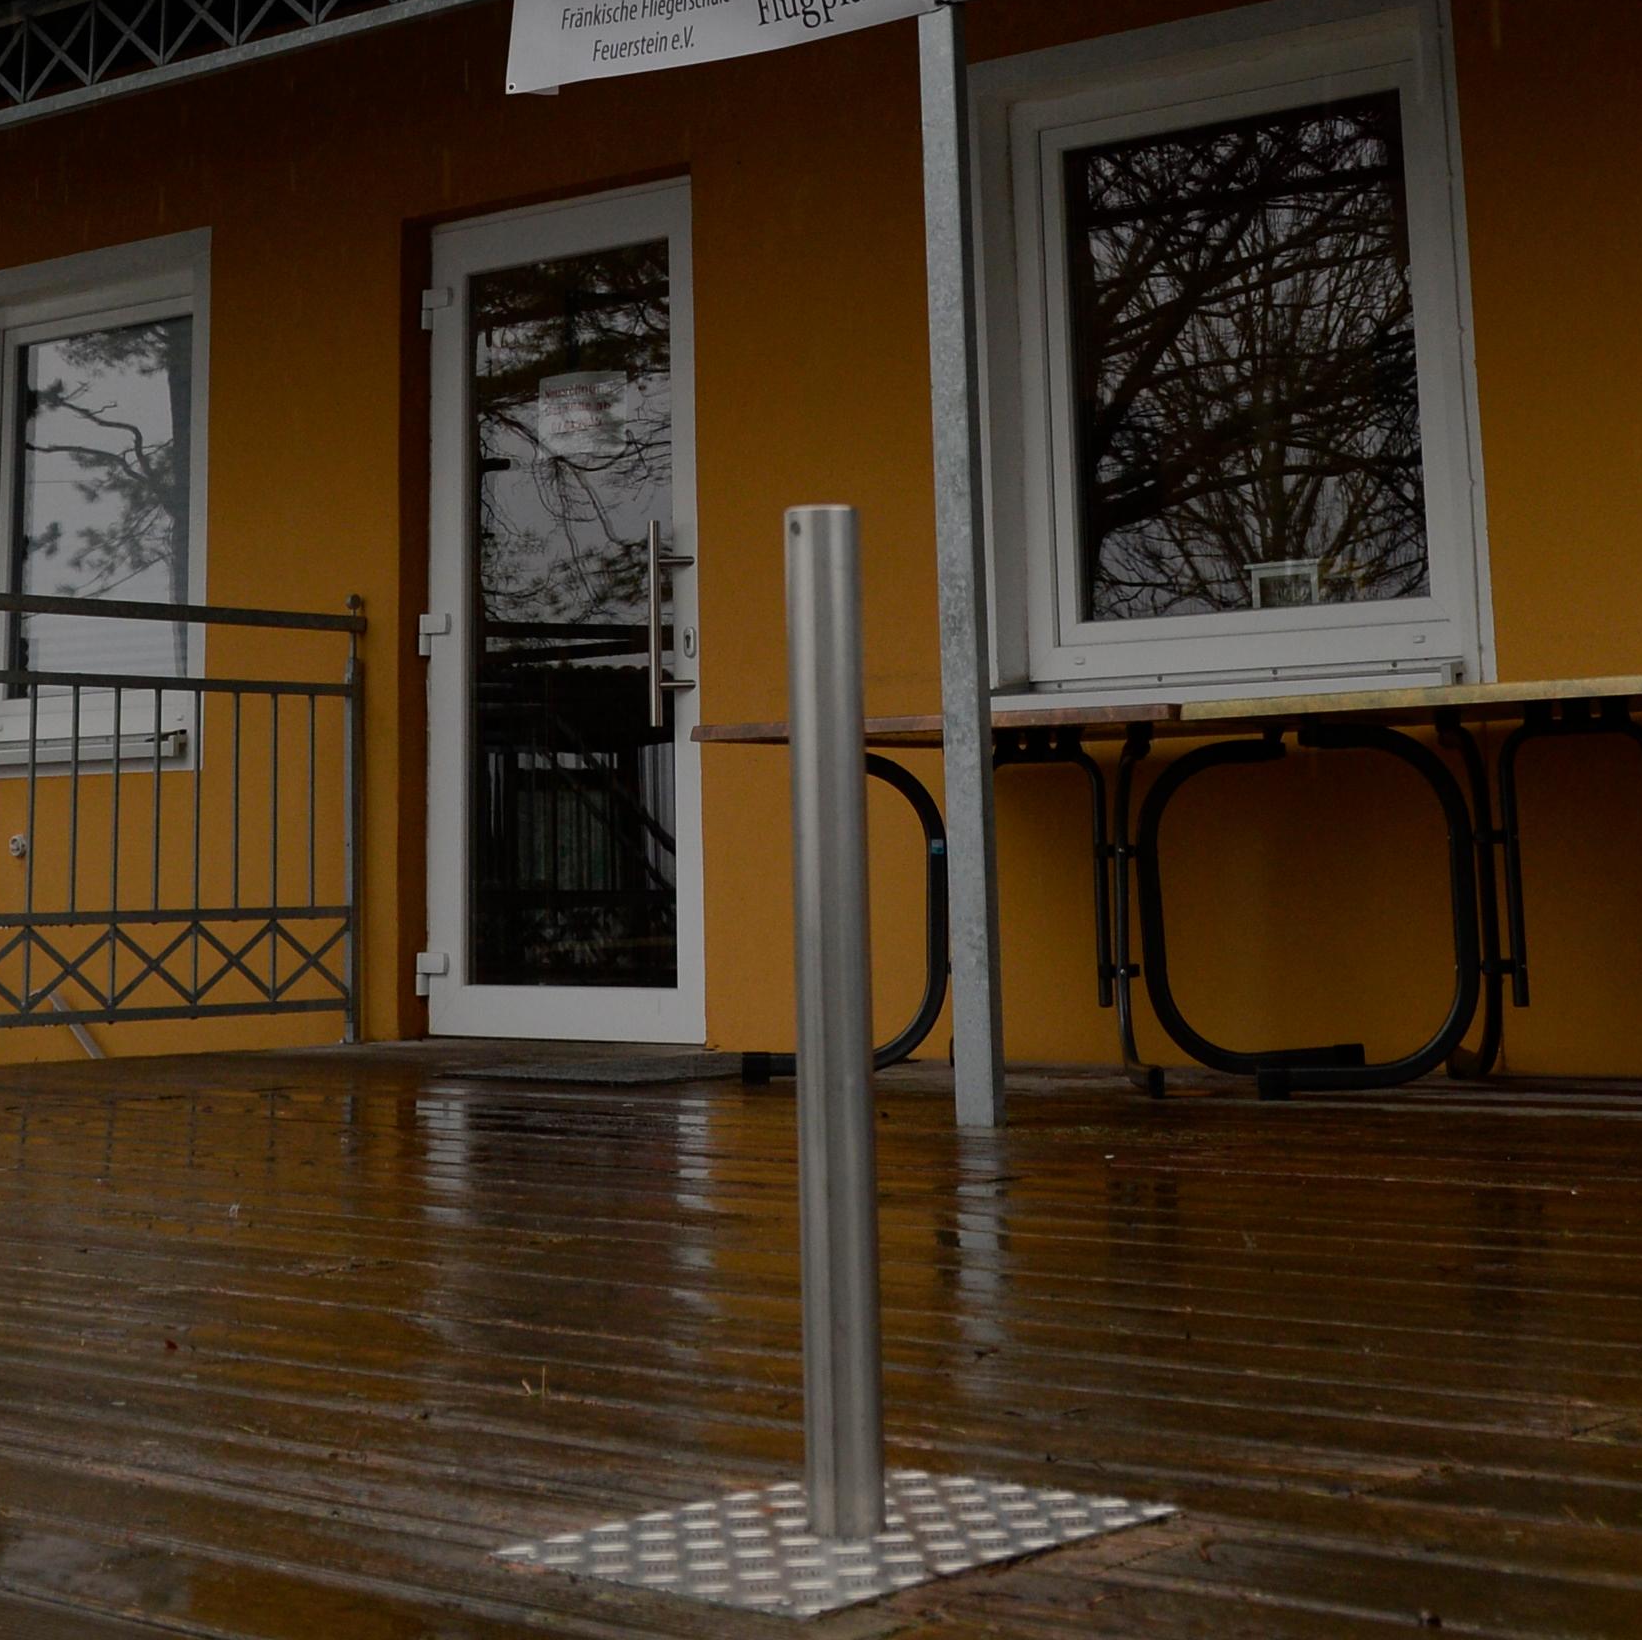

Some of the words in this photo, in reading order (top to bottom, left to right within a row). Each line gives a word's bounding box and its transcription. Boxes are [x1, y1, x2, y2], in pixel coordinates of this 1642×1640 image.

[560, 0, 639, 31] Fränkische
[592, 30, 669, 62] Feuerstein
[671, 25, 695, 51] e.V.
